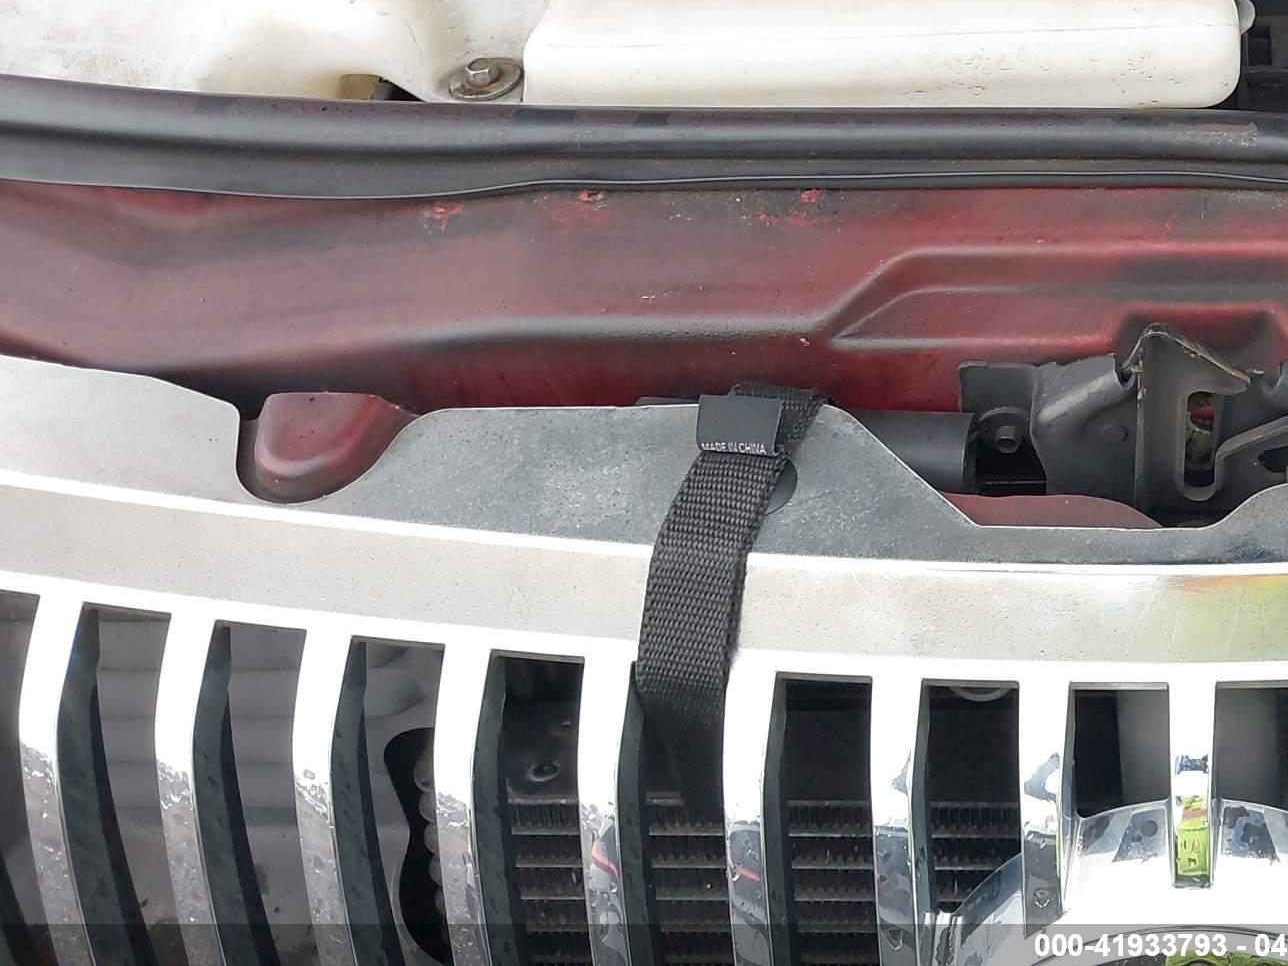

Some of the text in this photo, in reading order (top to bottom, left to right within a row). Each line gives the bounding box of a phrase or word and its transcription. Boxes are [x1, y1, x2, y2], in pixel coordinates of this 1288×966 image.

[701, 442, 768, 455] MADE IN CHINA
